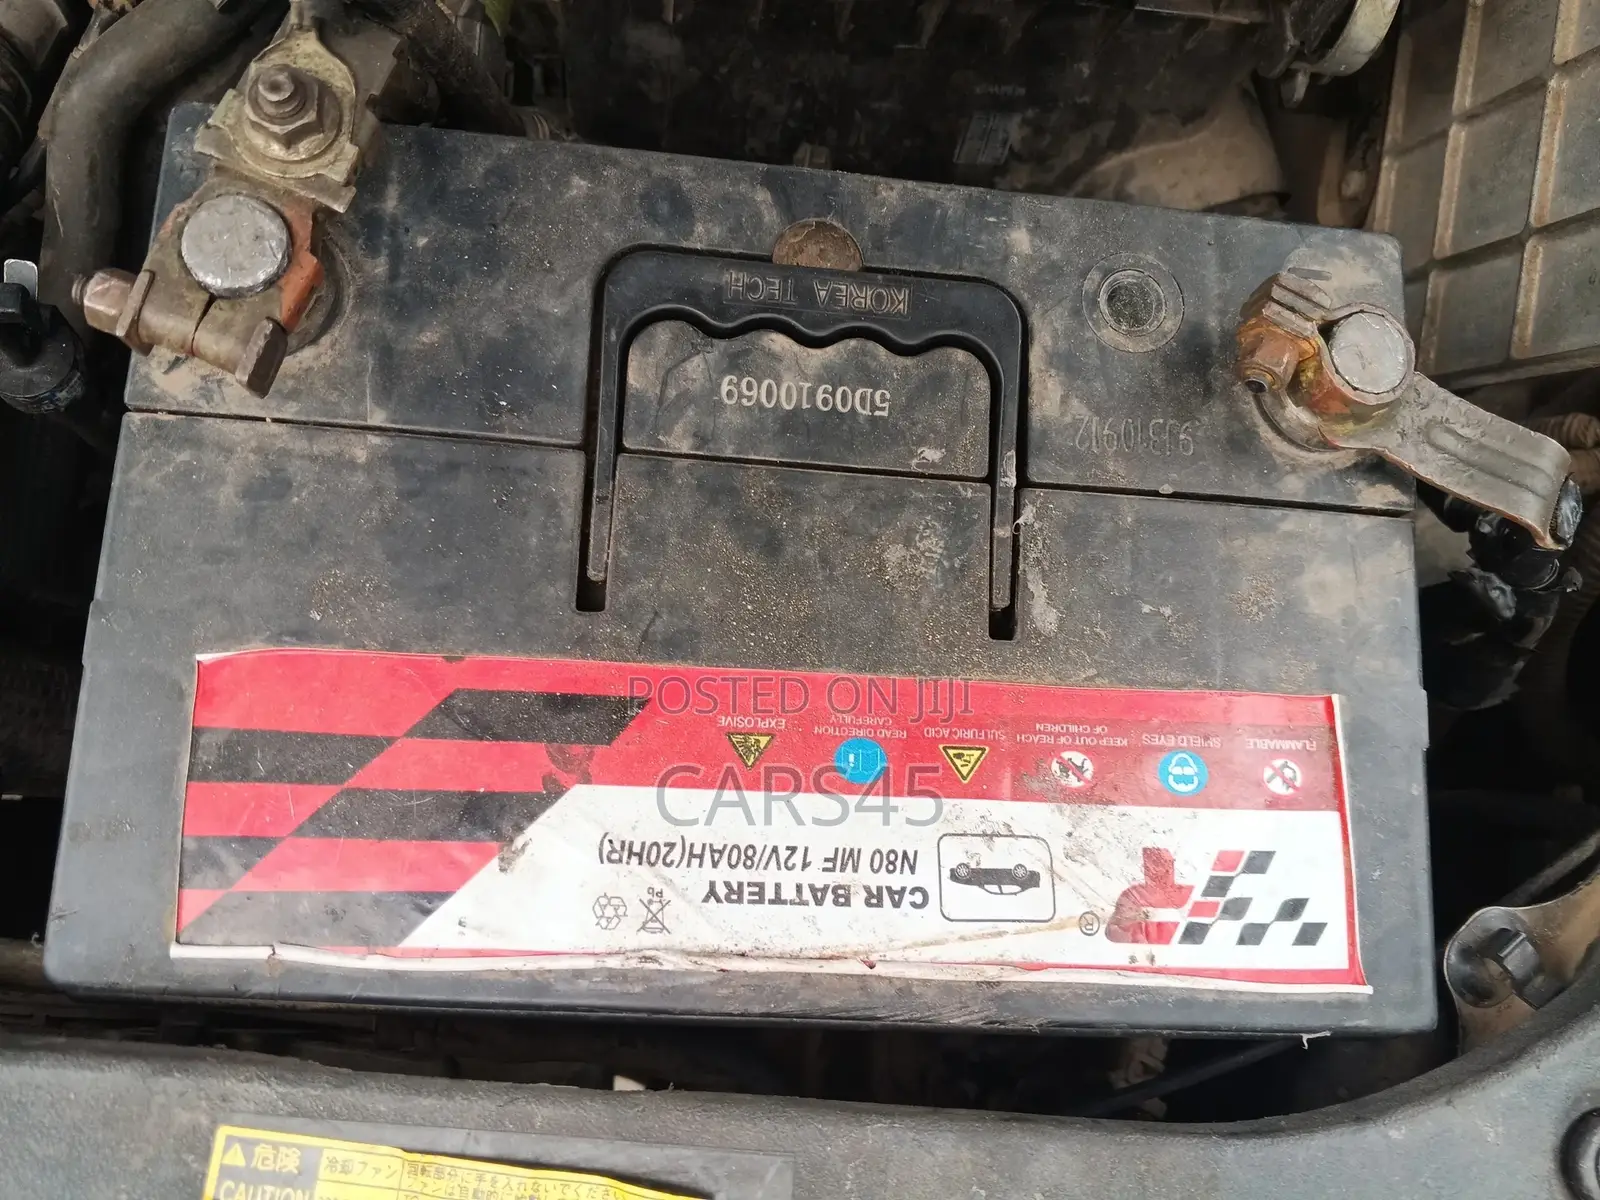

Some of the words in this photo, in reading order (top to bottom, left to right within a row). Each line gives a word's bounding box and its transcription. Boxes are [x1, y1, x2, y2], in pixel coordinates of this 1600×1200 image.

[728, 270, 795, 303] TECH
[813, 280, 911, 315] KOREA
[720, 375, 891, 417] 5D0910069
[718, 715, 786, 729] EXPLOSIVE
[830, 714, 892, 725] CAREFULLY
[877, 729, 907, 739] READ
[924, 727, 950, 738] ACID
[951, 728, 1005, 740] SULFURIC
[1035, 723, 1090, 734] CHILDREN
[1095, 724, 1108, 735] OF
[1016, 733, 1055, 745] REACH
[1056, 735, 1072, 745] OF
[1075, 735, 1099, 746] OUT
[1100, 735, 1128, 747] KEEP
[1142, 734, 1174, 746] EYES
[1178, 735, 1221, 749] SHIELD
[1245, 737, 1317, 751] FLAMMABLE
[598, 831, 813, 872] 12V/80AH(20HR)
[822, 846, 862, 874] MF
[869, 848, 918, 875] N80
[647, 886, 664, 899] Pb
[701, 880, 852, 908] BATTERY
[865, 885, 930, 910] CAR
[251, 1142, 302, 1175] 危険
[324, 1155, 398, 1179] 冷却ファン
